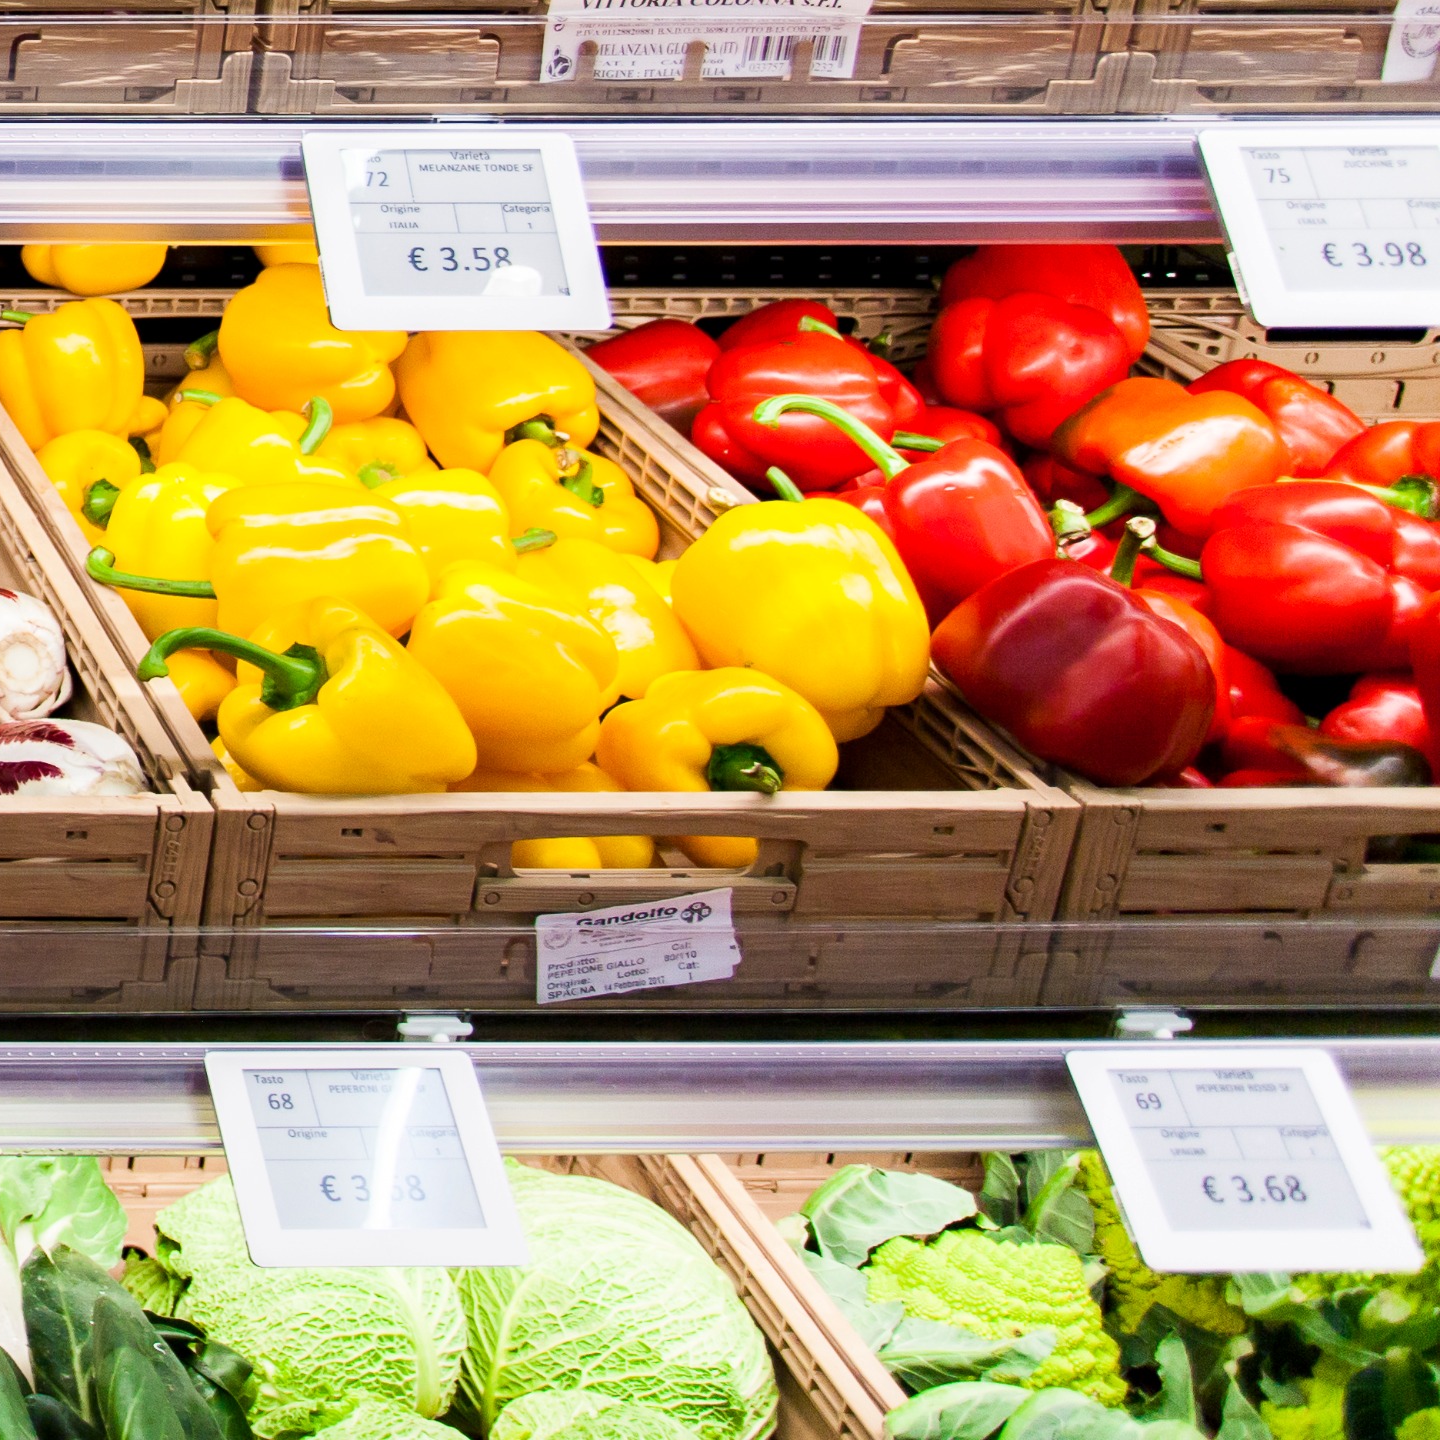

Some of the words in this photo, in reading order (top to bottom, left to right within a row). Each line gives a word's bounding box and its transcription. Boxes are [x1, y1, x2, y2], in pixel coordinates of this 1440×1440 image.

[450, 150, 490, 161] Varietà
[418, 164, 481, 172] MELANZANE
[484, 164, 520, 172] TONDE
[522, 164, 534, 172] SF
[1264, 168, 1290, 184] 75
[366, 171, 390, 187] 72
[388, 222, 418, 230] ITALIA
[408, 246, 428, 272] €
[440, 246, 512, 272] 3.58
[1321, 242, 1342, 268] €
[1352, 242, 1426, 268] 3.98
[576, 906, 678, 927] Gandolfo
[547, 964, 603, 979] PEPERONE
[606, 957, 645, 969] GIALLO
[617, 967, 649, 978] Lotto:
[254, 1074, 284, 1085] Tasto
[328, 1084, 378, 1094] PEPERONI
[268, 1092, 294, 1110] 68
[1136, 1092, 1162, 1110] 69
[288, 1129, 328, 1140] Origine
[319, 1174, 342, 1202] €
[1202, 1175, 1224, 1203] €
[1231, 1175, 1306, 1203] 3.68
